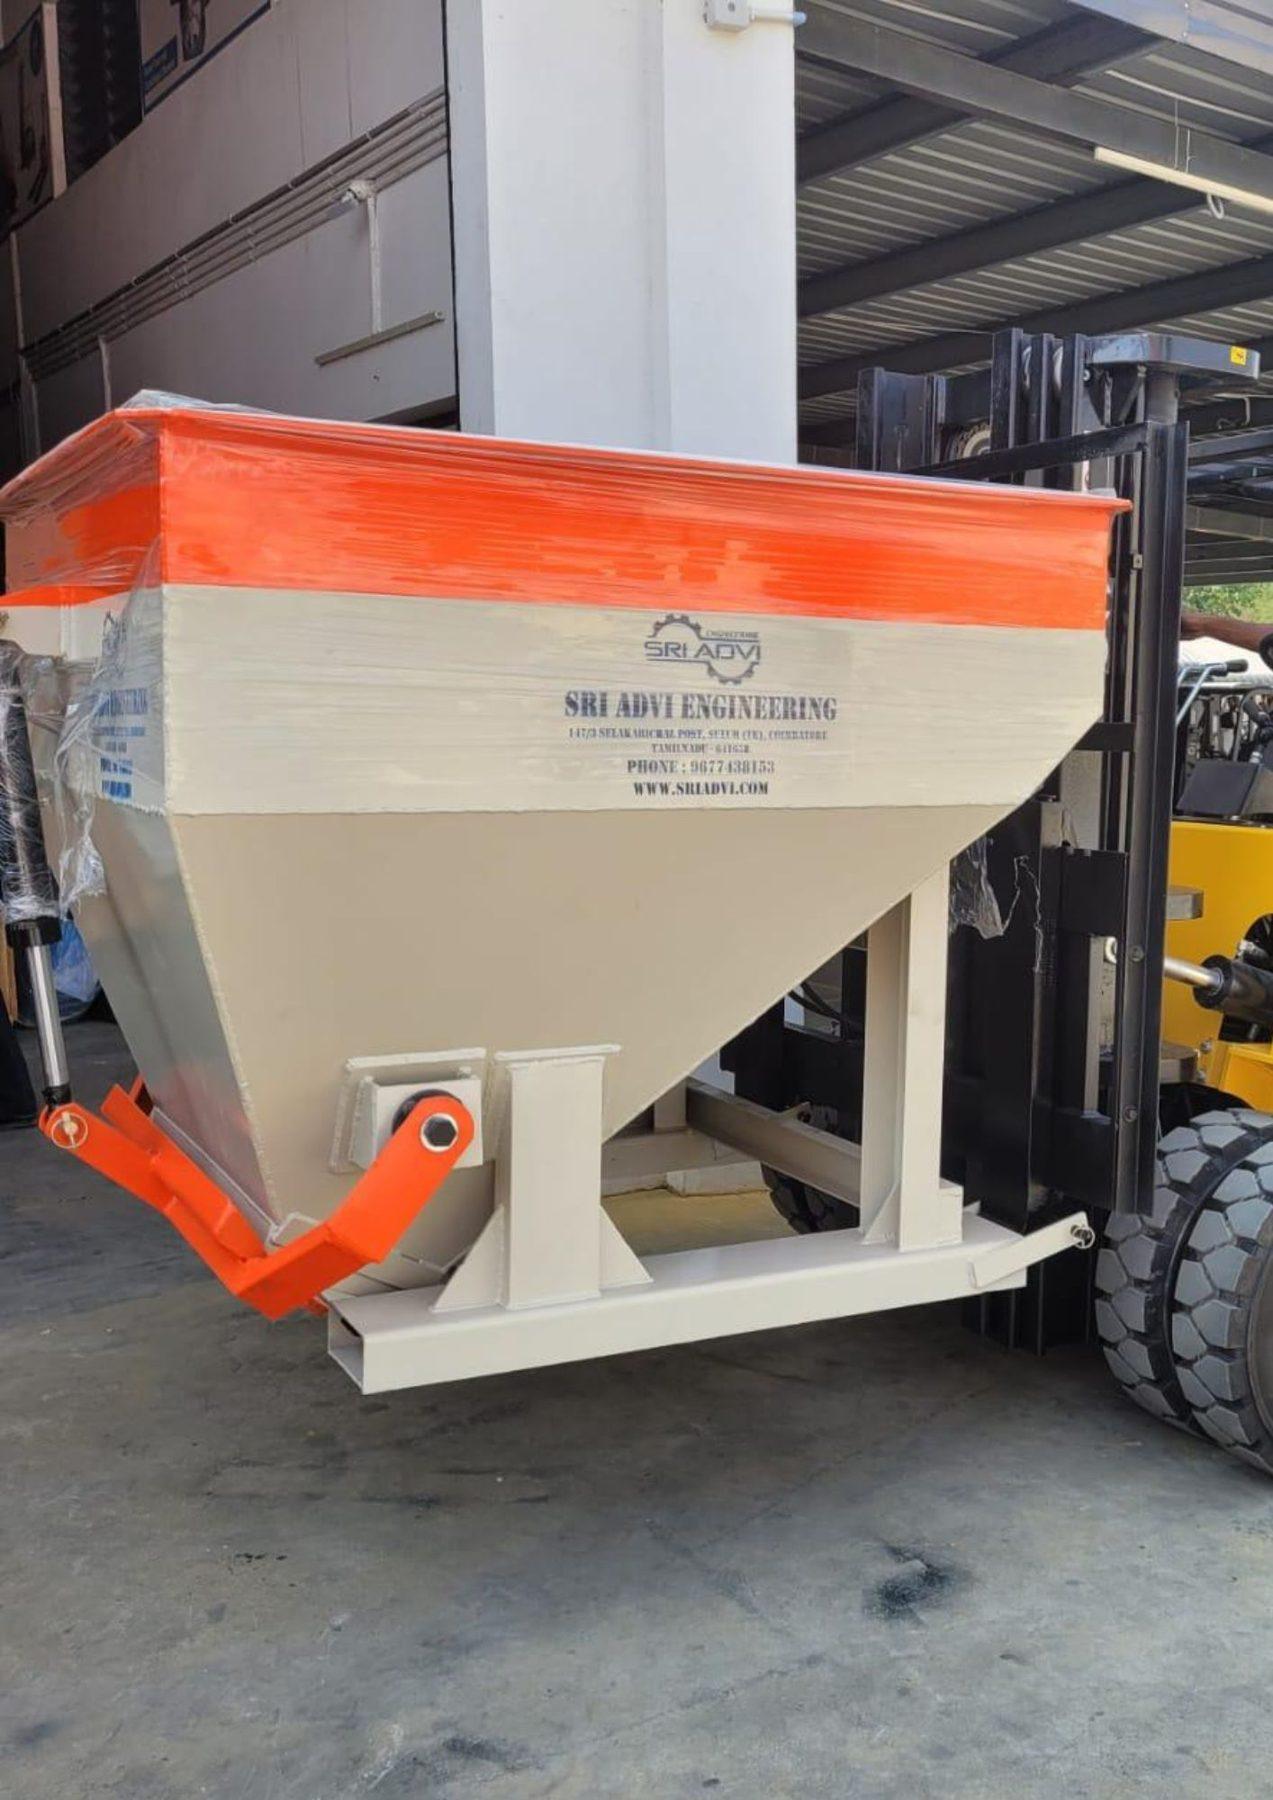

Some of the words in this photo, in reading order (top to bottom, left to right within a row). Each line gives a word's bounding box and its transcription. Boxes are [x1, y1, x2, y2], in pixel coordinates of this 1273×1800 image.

[644, 641, 687, 658] SRI
[694, 642, 761, 660] ADVI
[564, 690, 608, 717] SRI
[615, 692, 673, 718] ADVI
[681, 693, 837, 720] ENGINEERING
[627, 760, 677, 773] PHONE
[634, 781, 768, 796] WWW.SRIADVI.COM
